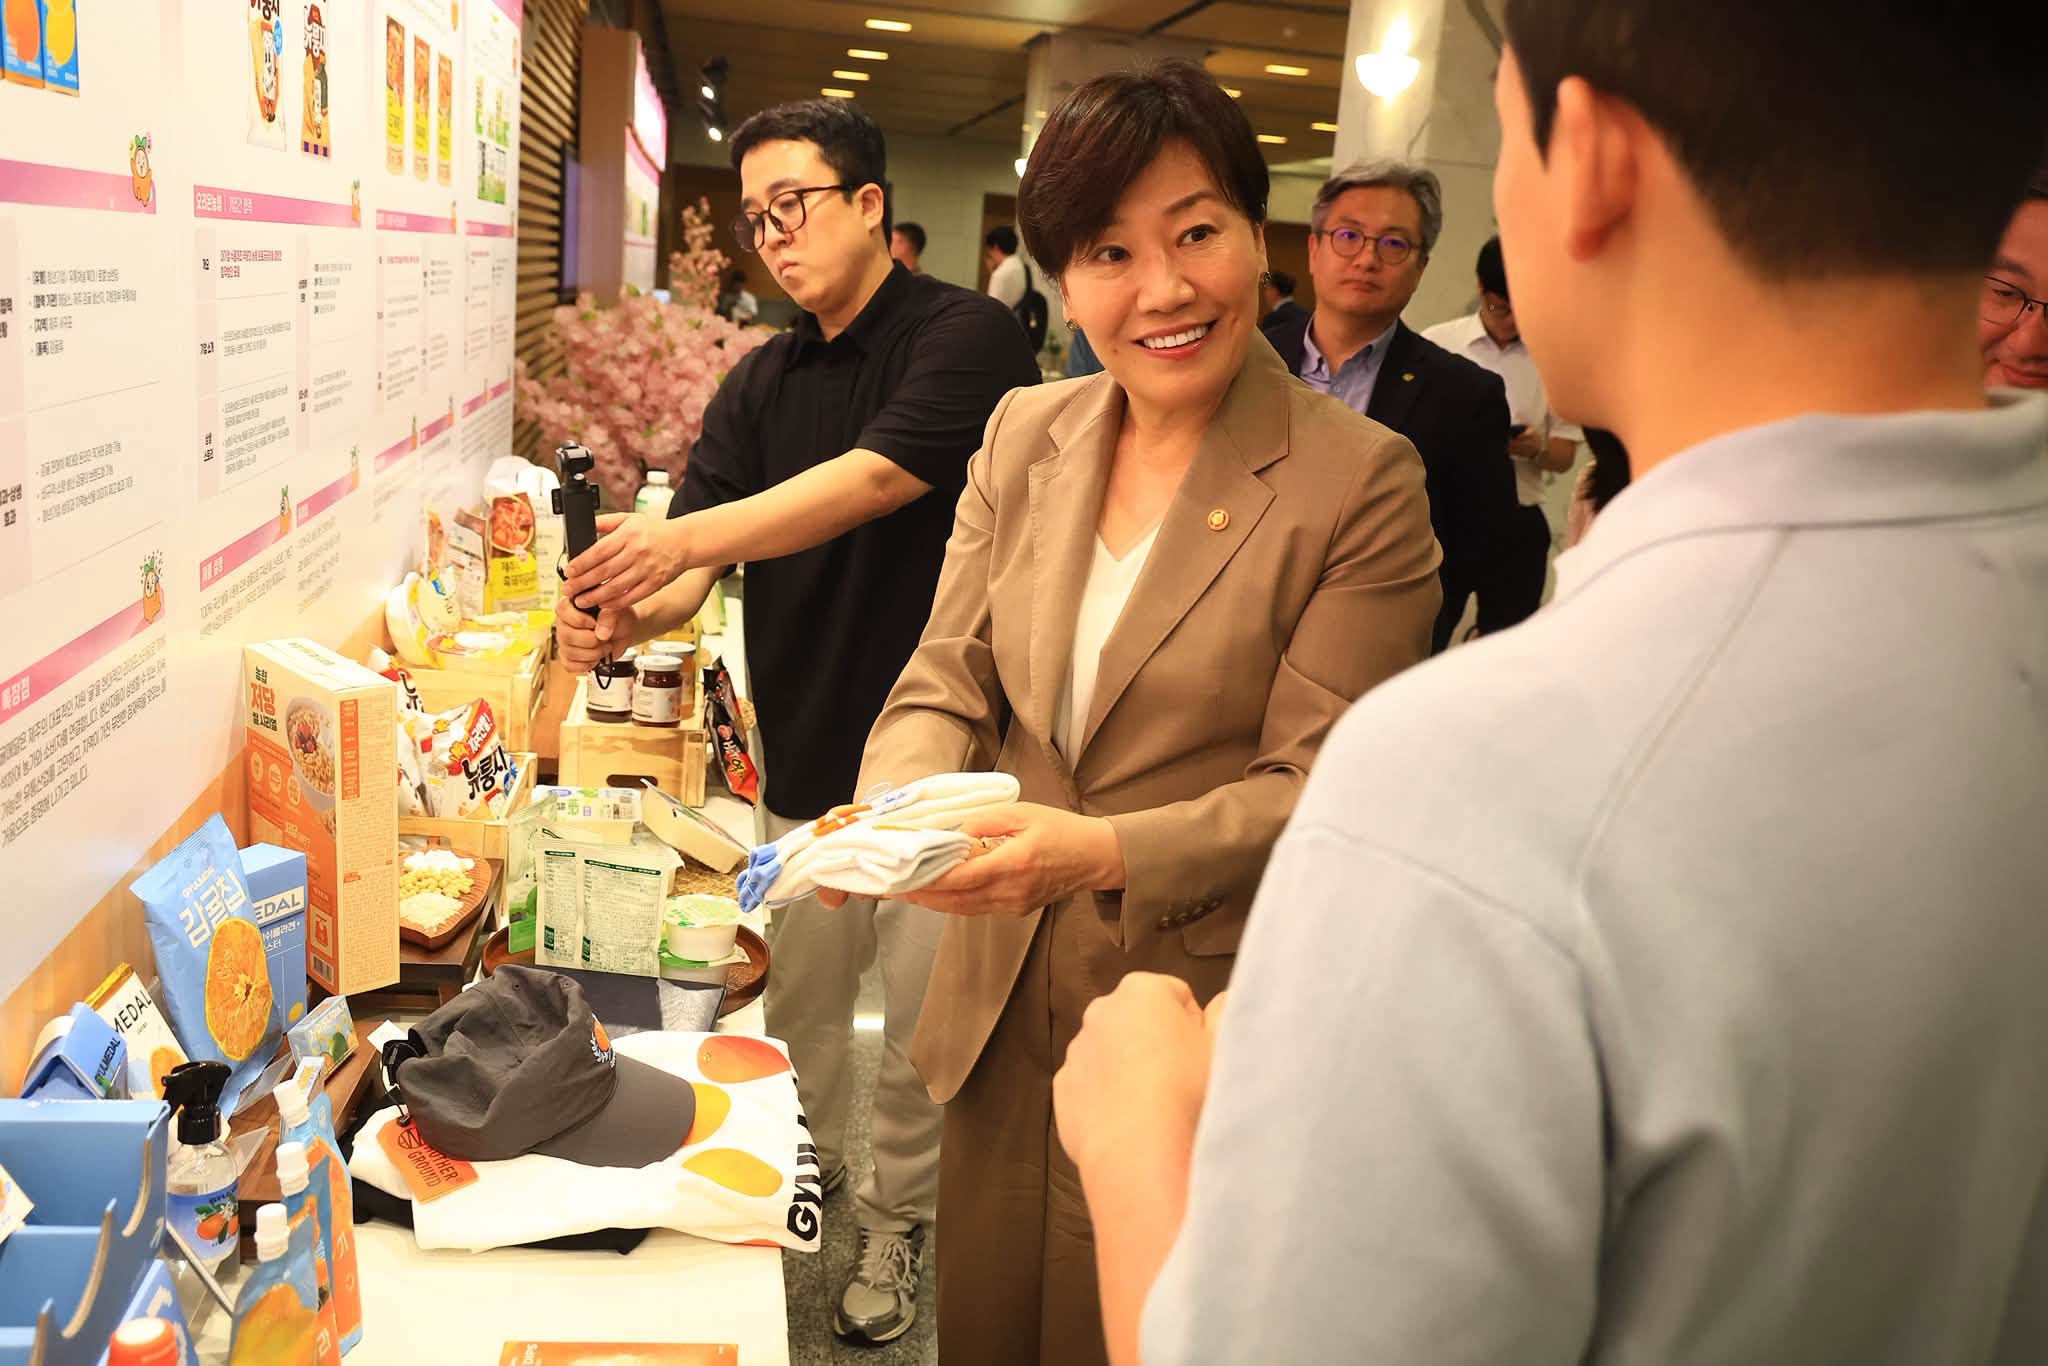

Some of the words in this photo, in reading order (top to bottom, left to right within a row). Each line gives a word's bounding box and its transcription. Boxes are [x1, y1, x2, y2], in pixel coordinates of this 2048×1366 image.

[250, 682, 276, 716] 저당
[264, 938, 281, 952] 스터
[407, 1150, 442, 1188] GROUND
